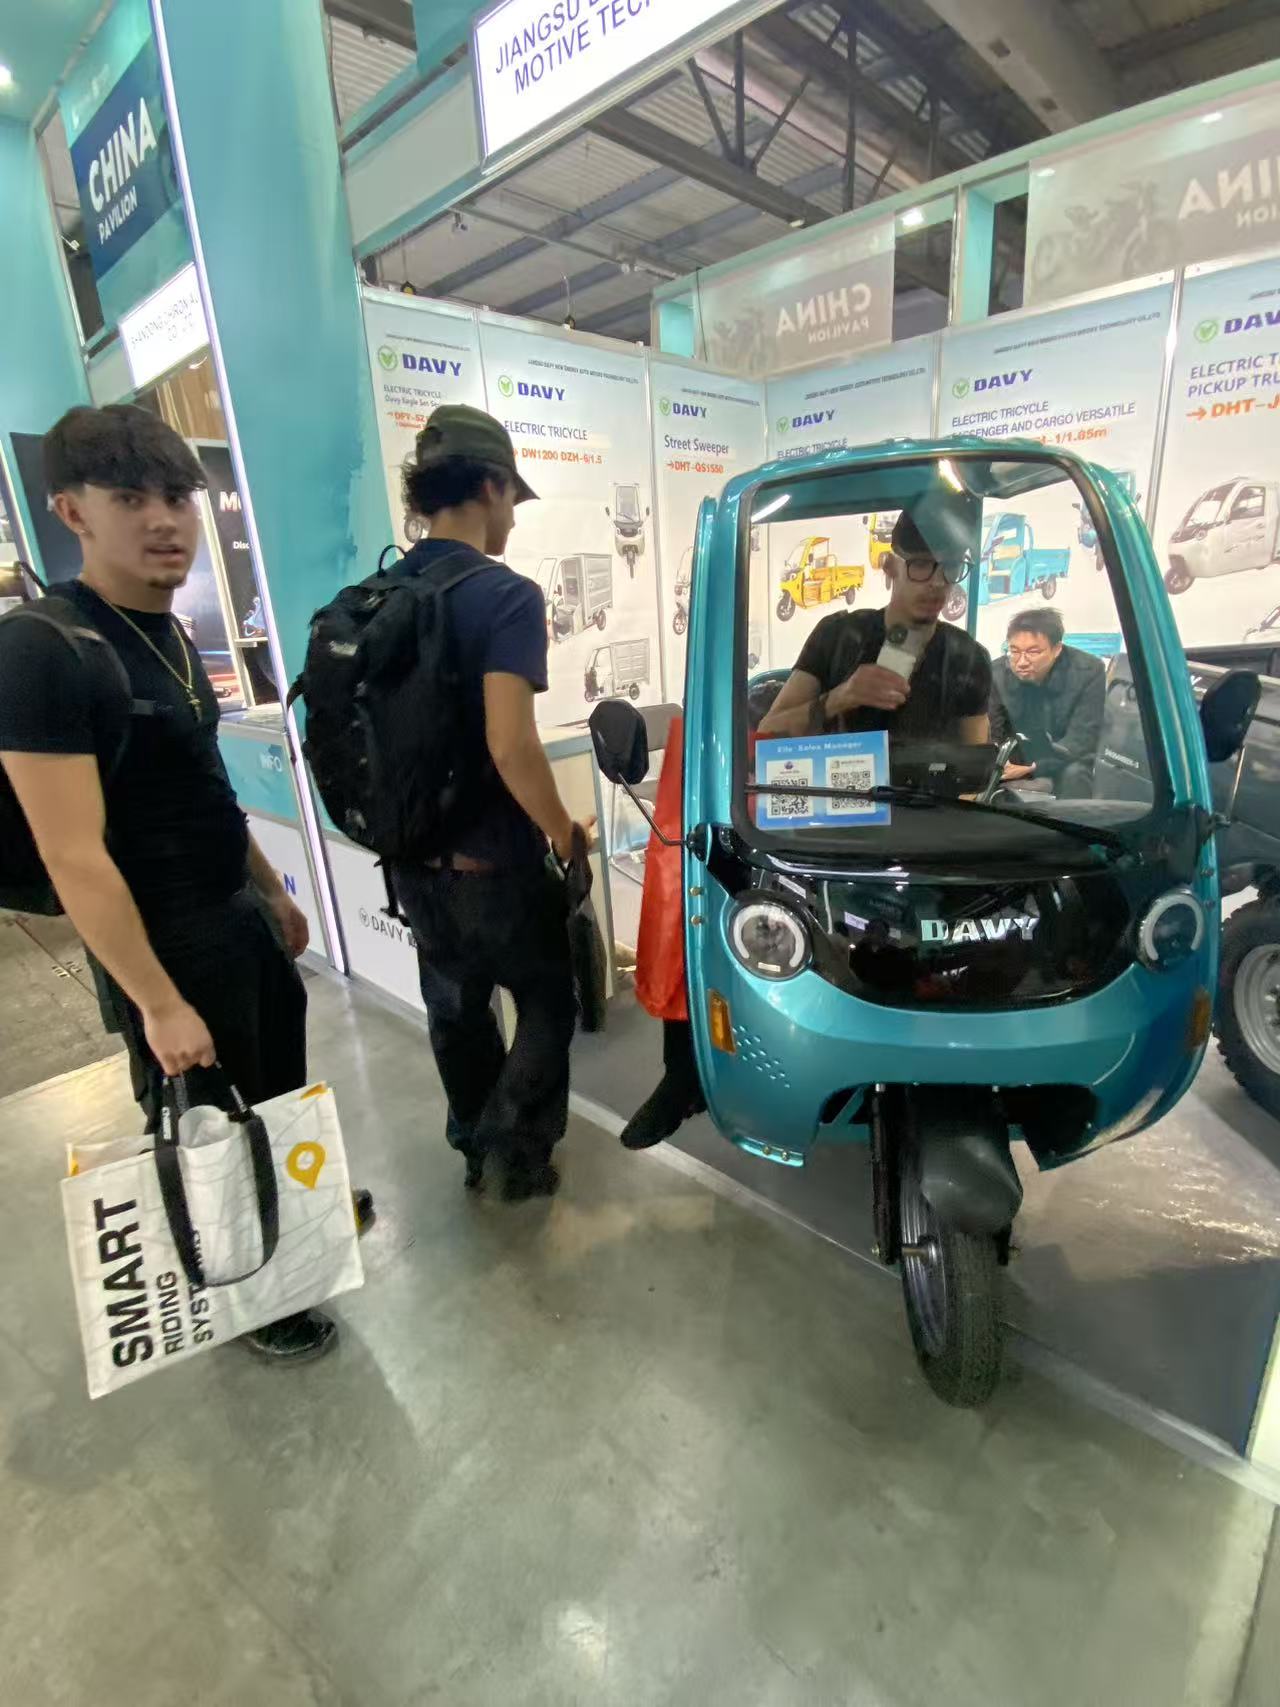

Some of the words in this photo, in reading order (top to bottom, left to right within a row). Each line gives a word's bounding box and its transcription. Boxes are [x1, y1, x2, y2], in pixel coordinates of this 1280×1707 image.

[495, 0, 580, 74] JIANGSU
[514, 19, 591, 95] MOTIVE
[597, 0, 650, 35] TEC
[88, 96, 158, 213] CHINA
[98, 185, 138, 245] PAVILION
[402, 353, 462, 377] DAVY
[1190, 354, 1264, 380] ELECTRIC
[517, 381, 566, 401] DAVY
[973, 368, 1034, 392] DAVY
[1188, 377, 1247, 398] PICKUP
[672, 402, 708, 419] DAVY
[791, 409, 837, 428] DAVY
[952, 410, 998, 428] ELECTRIC
[1000, 401, 1049, 419] TRICYCLE
[1011, 420, 1032, 433] AND
[1034, 413, 1073, 429] CARGO
[1075, 402, 1136, 422] VERSATILE
[504, 420, 547, 436] ELECTRIC
[548, 425, 588, 441] TRICYCLE
[521, 447, 559, 461] DW1200
[664, 434, 692, 450] Street
[693, 438, 729, 456] Sweeper
[372, 915, 404, 942] DAVY
[920, 917, 1041, 942] DAVY
[93, 1197, 153, 1369] SMART
[156, 1270, 185, 1356] RIDING
